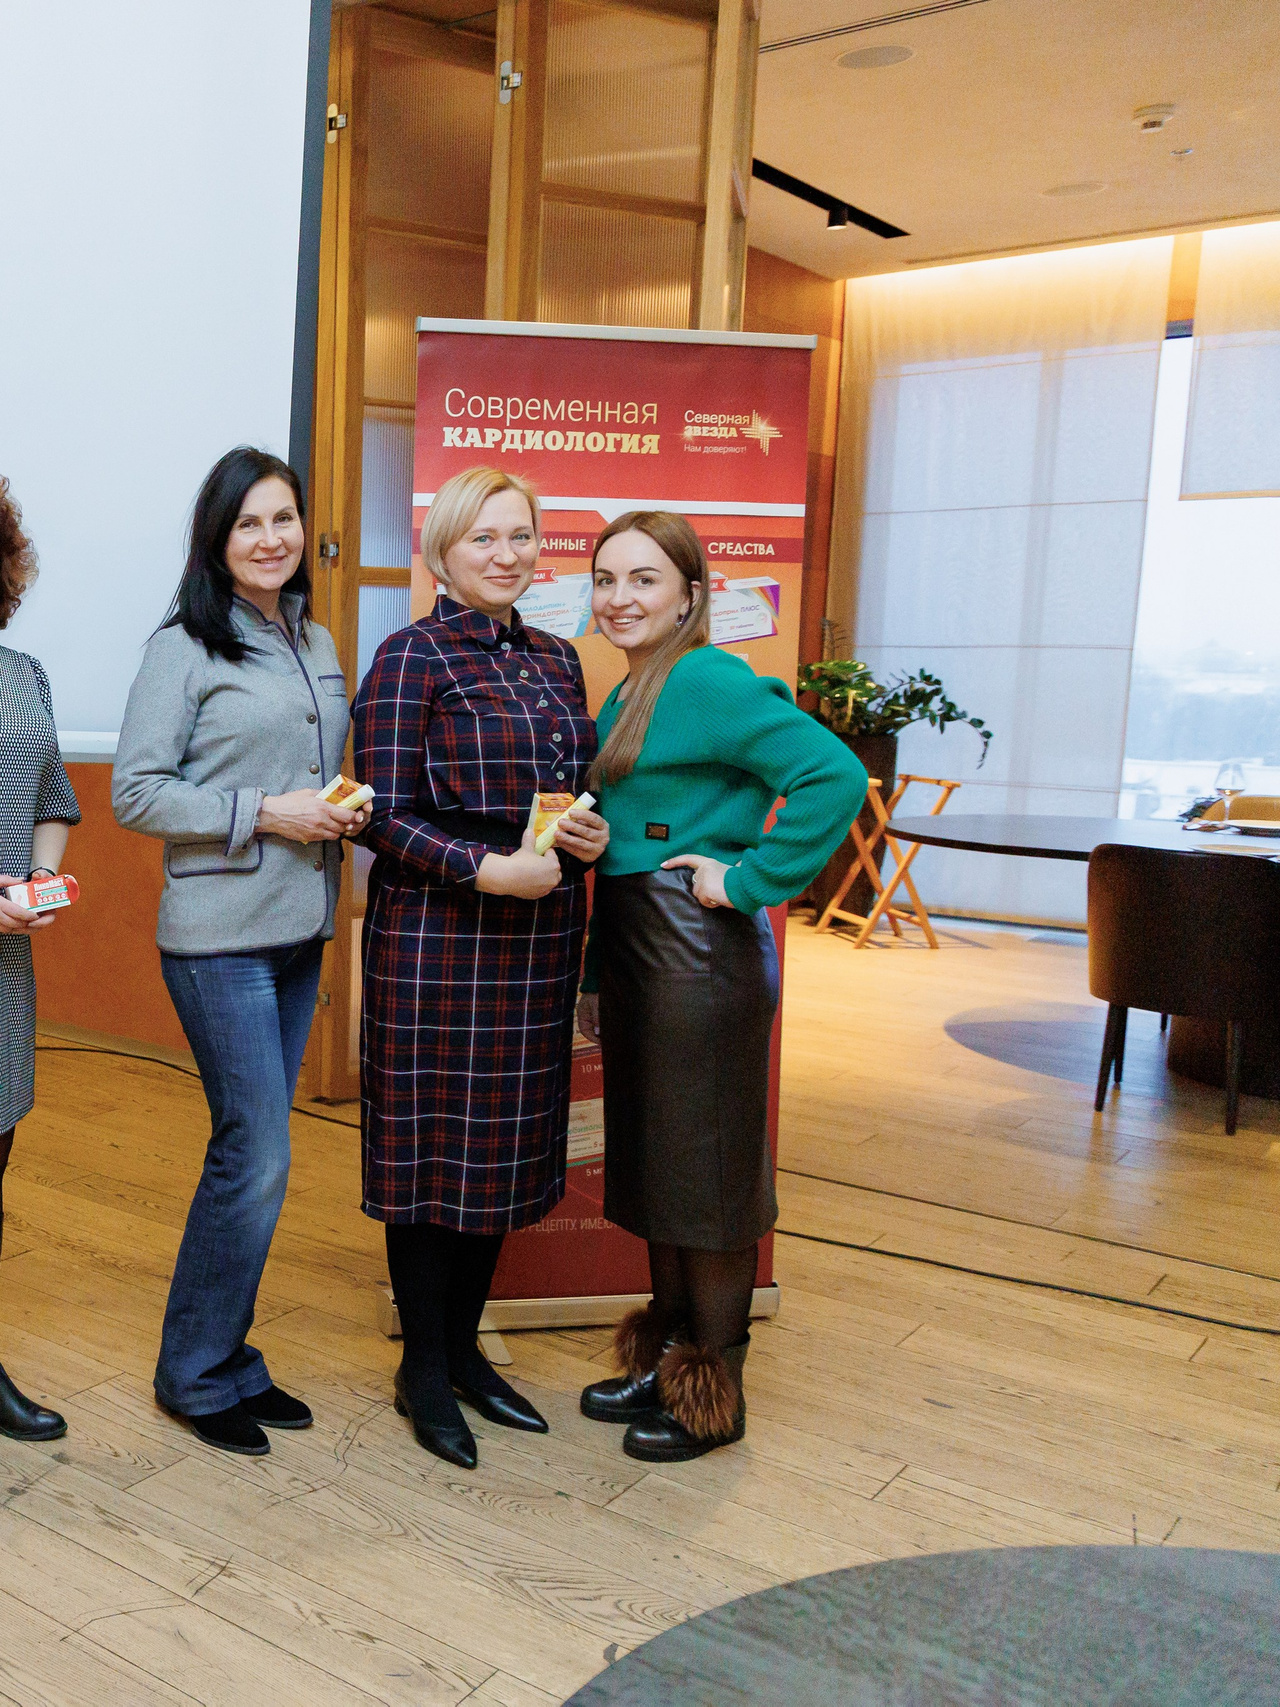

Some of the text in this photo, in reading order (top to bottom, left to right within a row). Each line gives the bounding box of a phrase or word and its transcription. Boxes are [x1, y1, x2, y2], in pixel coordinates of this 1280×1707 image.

[445, 388, 658, 426] Современная
[684, 410, 749, 426] Северная
[684, 425, 738, 438] ЗВЕЗДА
[442, 426, 660, 455] КАРДИОЛОГИЯ
[684, 444, 701, 452] Нам
[703, 446, 747, 454] доверяют!
[539, 538, 586, 551] АННЫЕ
[708, 542, 775, 556] СРЕДСТВА
[580, 1064, 592, 1073] 10
[586, 1168, 592, 1177] 5
[580, 1217, 618, 1230] ИМЕЮ
